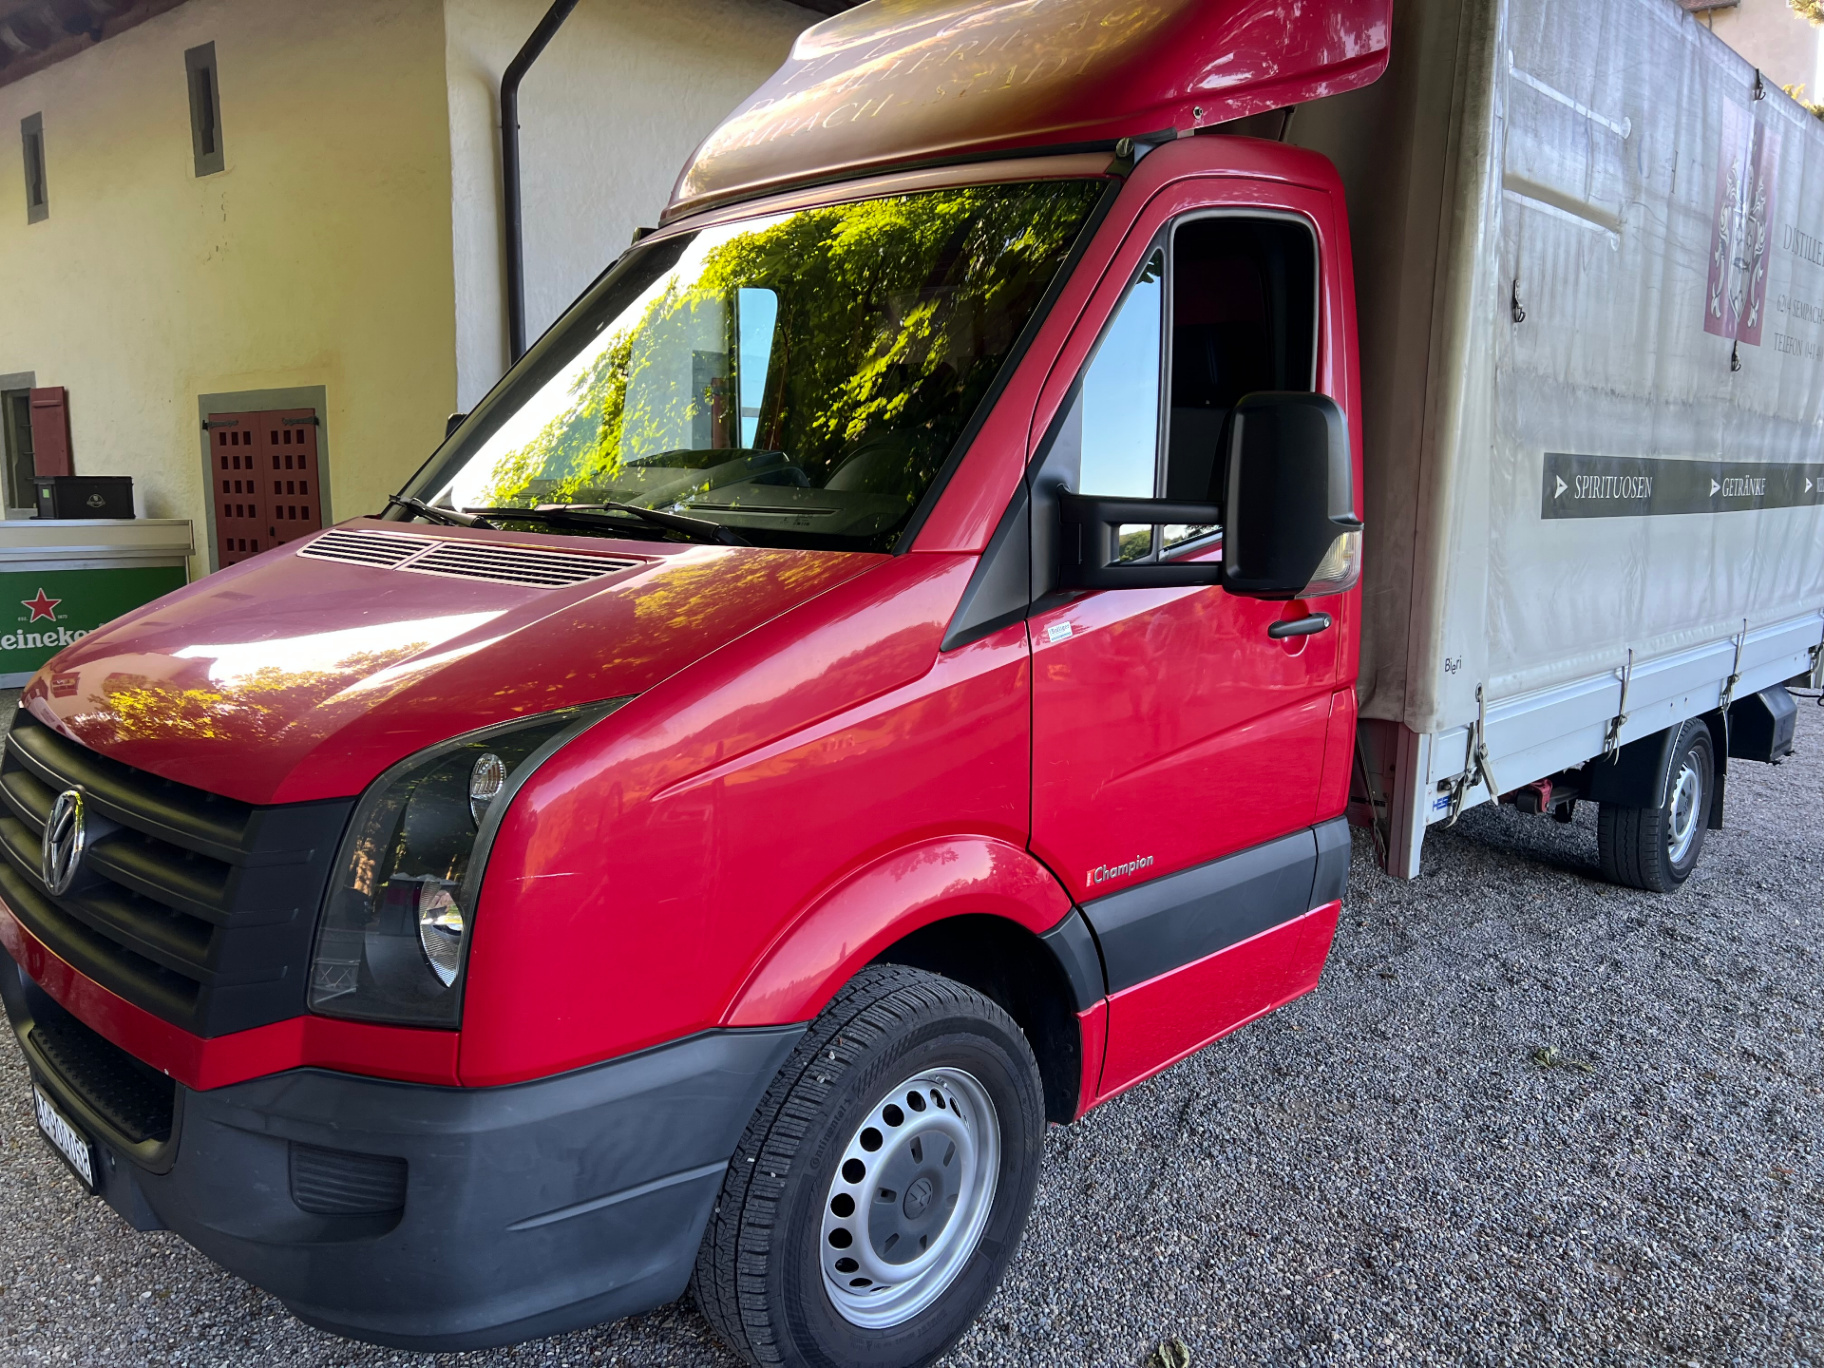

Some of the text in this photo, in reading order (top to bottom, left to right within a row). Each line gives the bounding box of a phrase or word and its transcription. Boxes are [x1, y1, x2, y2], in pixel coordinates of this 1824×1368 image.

[1783, 223, 1824, 267] DISTILLE
[1774, 332, 1803, 357] TELEFON
[1574, 474, 1767, 499] SPIRITUOSEN GETRÄNKE
[0, 626, 96, 650] eineke
[1444, 655, 1462, 675] Bieri
[1094, 855, 1154, 883] Champion
[809, 1104, 847, 1170] Continental
